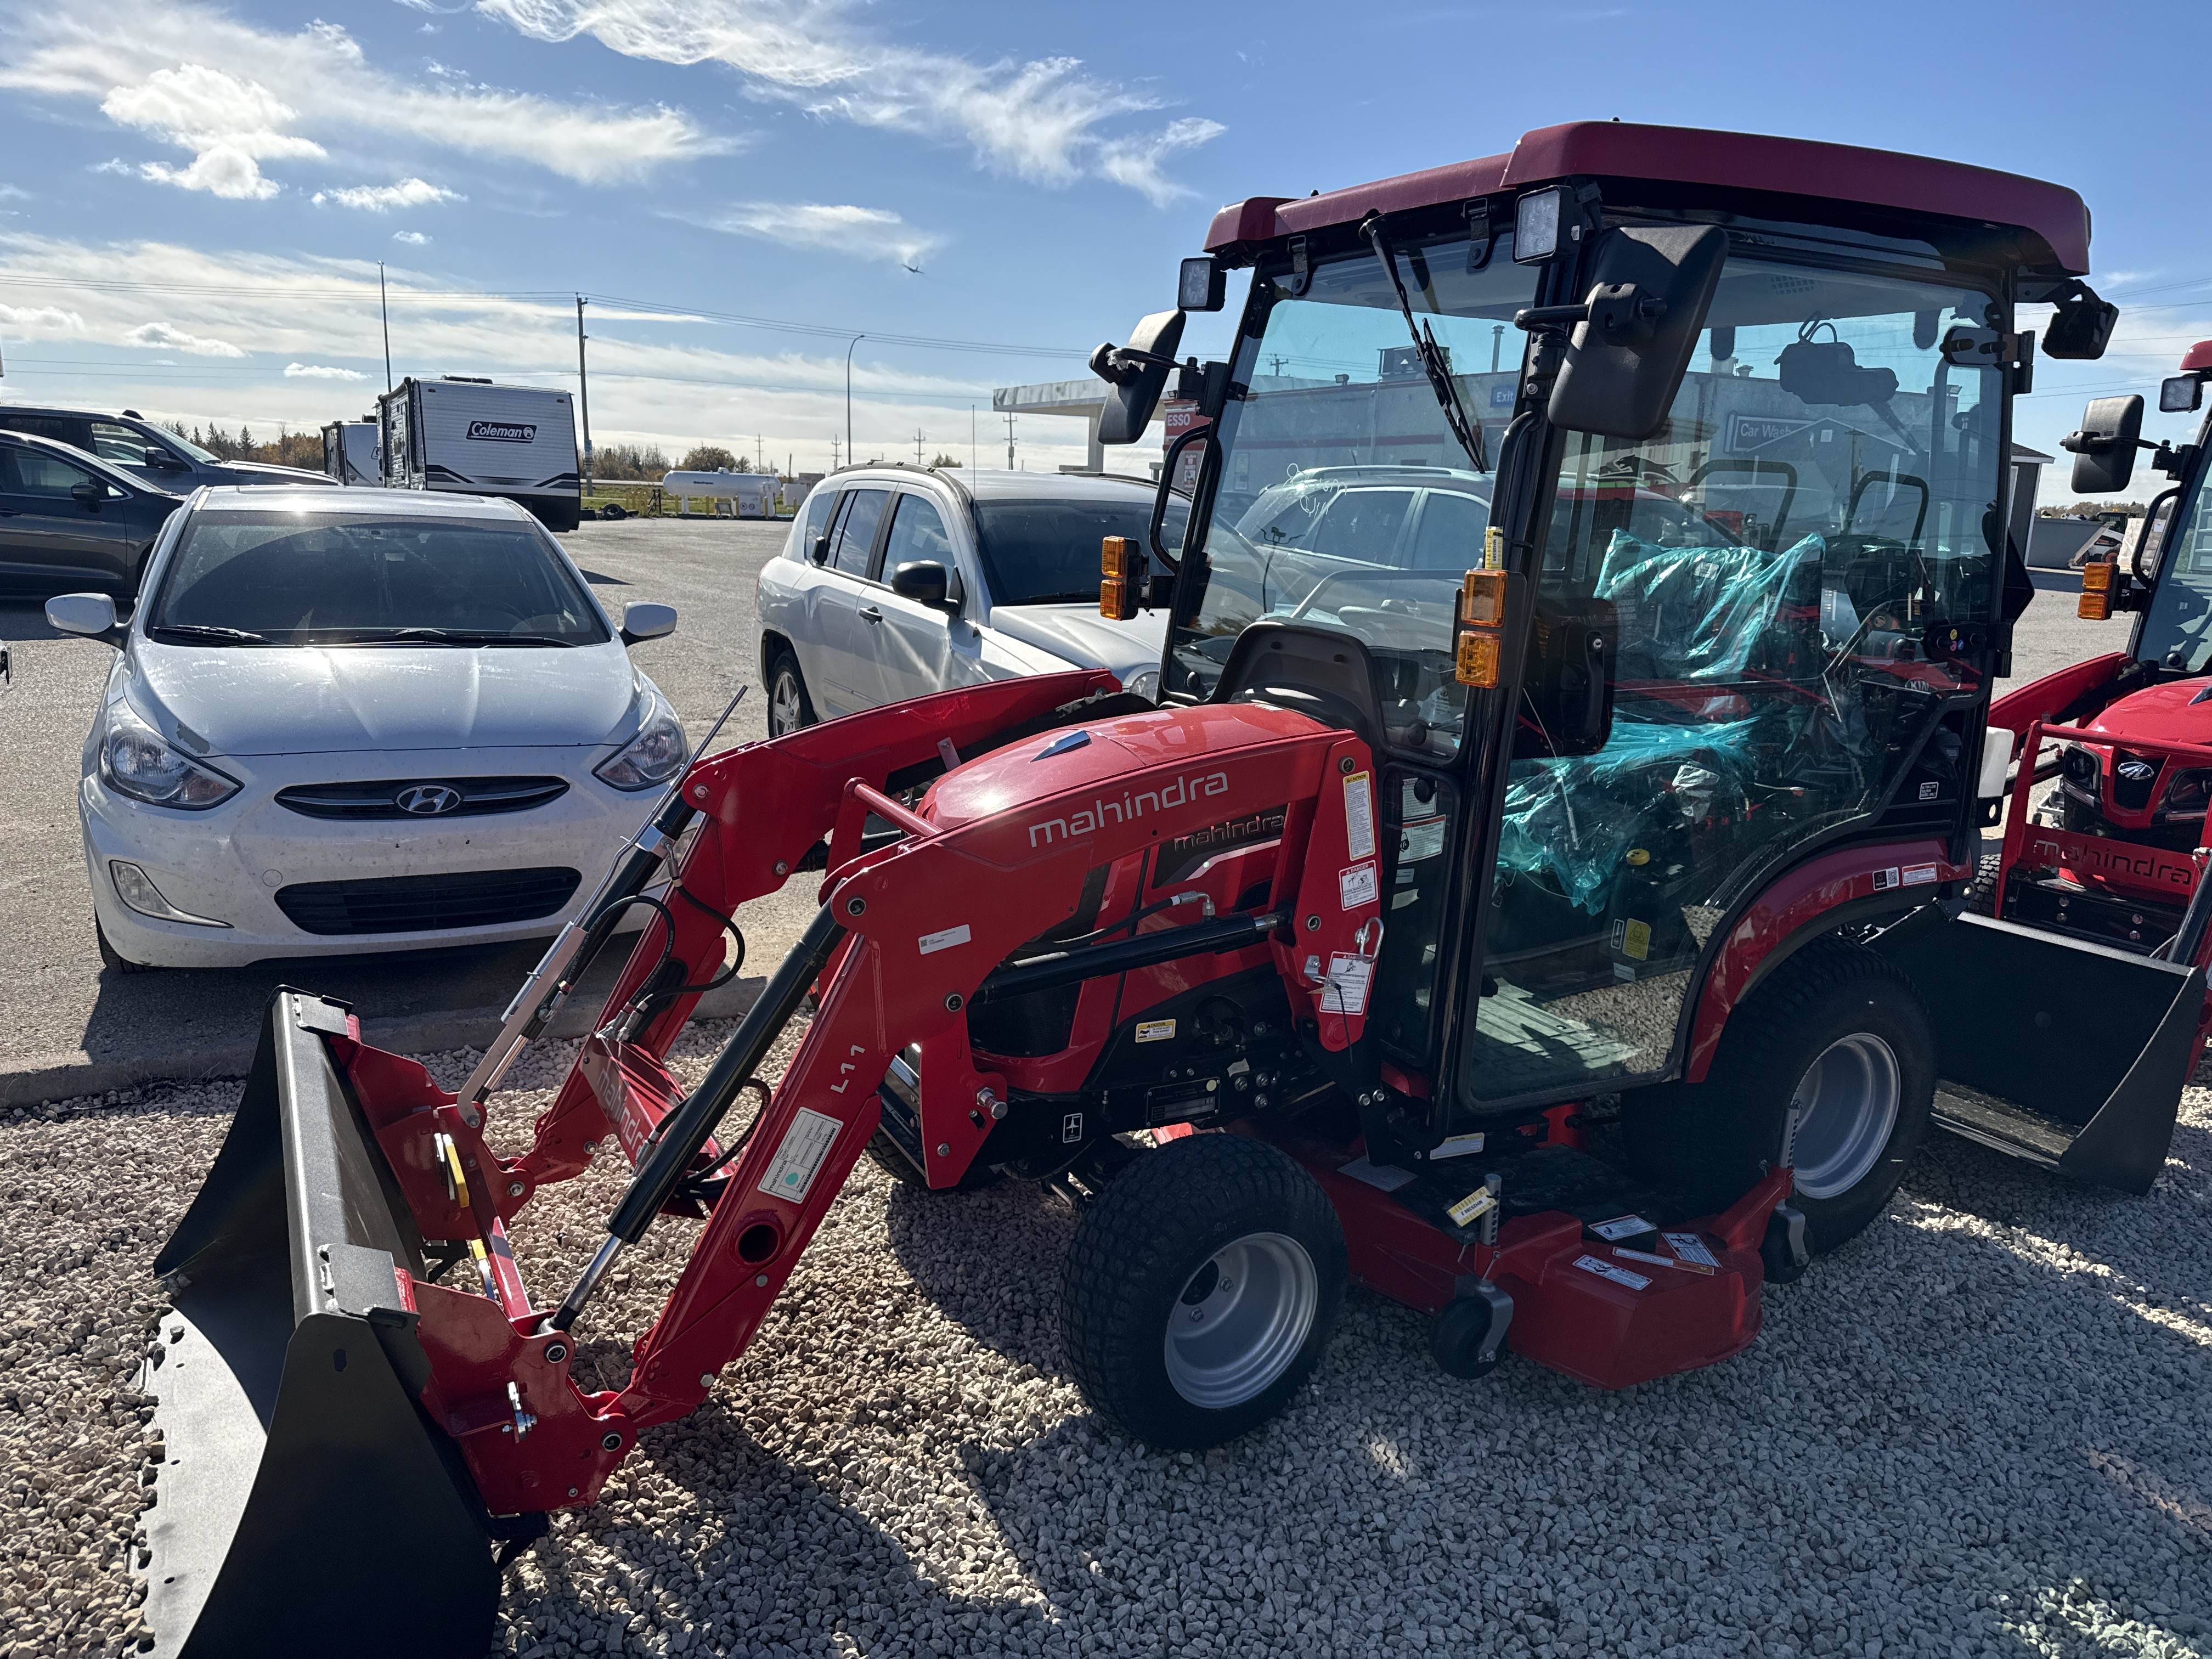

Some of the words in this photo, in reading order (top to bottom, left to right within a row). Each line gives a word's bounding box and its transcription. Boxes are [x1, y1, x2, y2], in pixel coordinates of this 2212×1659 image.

[1497, 391, 1514, 402] Exit
[1167, 413, 1190, 427] ESSO
[471, 422, 522, 438] Coleman
[1740, 423, 1759, 437] Car
[1762, 424, 1791, 438] Wash
[1910, 680, 1927, 691] KIA
[1029, 771, 1229, 848] mahindra
[1173, 814, 1285, 851] mahindra
[1351, 864, 1369, 873] DANGER
[2033, 838, 2192, 885] mahindra
[830, 1044, 865, 1093] L11
[769, 1160, 787, 1191] mahindra
